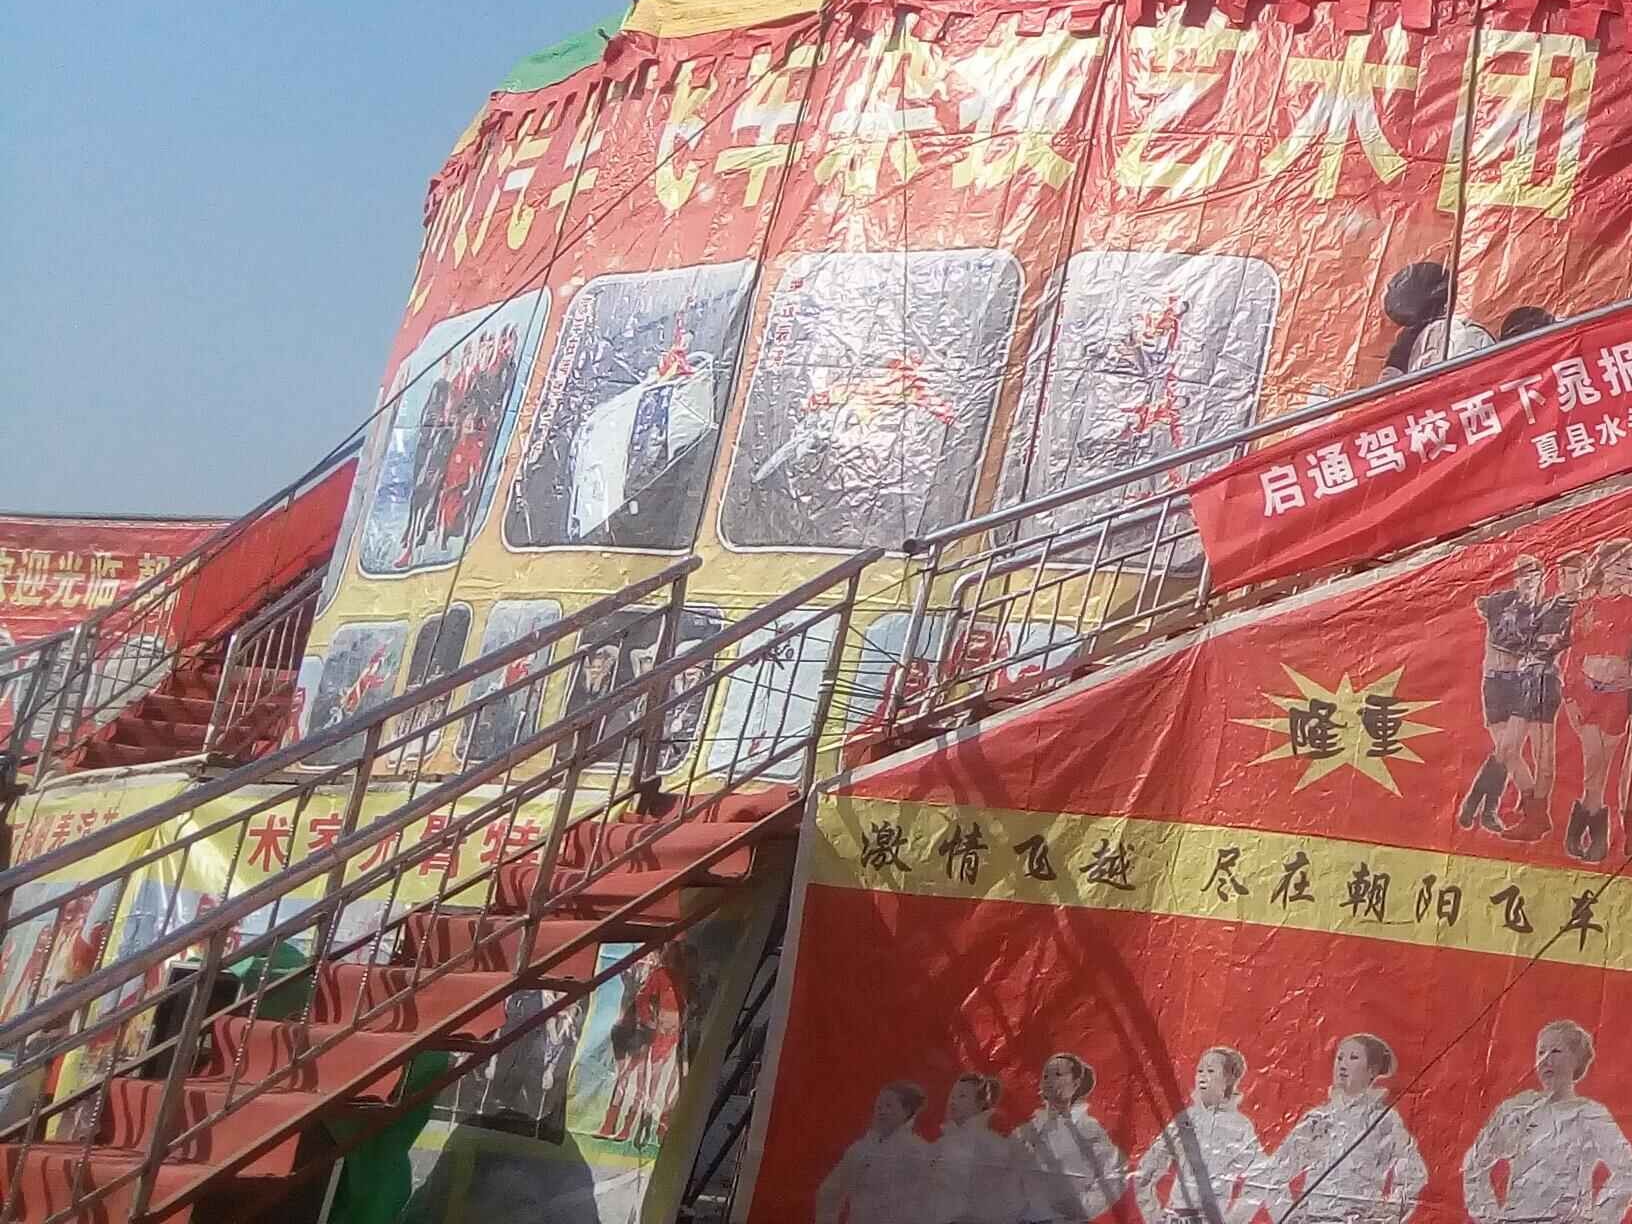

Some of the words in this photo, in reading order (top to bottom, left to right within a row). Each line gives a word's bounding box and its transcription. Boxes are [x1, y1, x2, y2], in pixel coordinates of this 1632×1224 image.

[1289, 693, 1411, 758] 隆重
[860, 820, 1136, 891] 激情飞越
